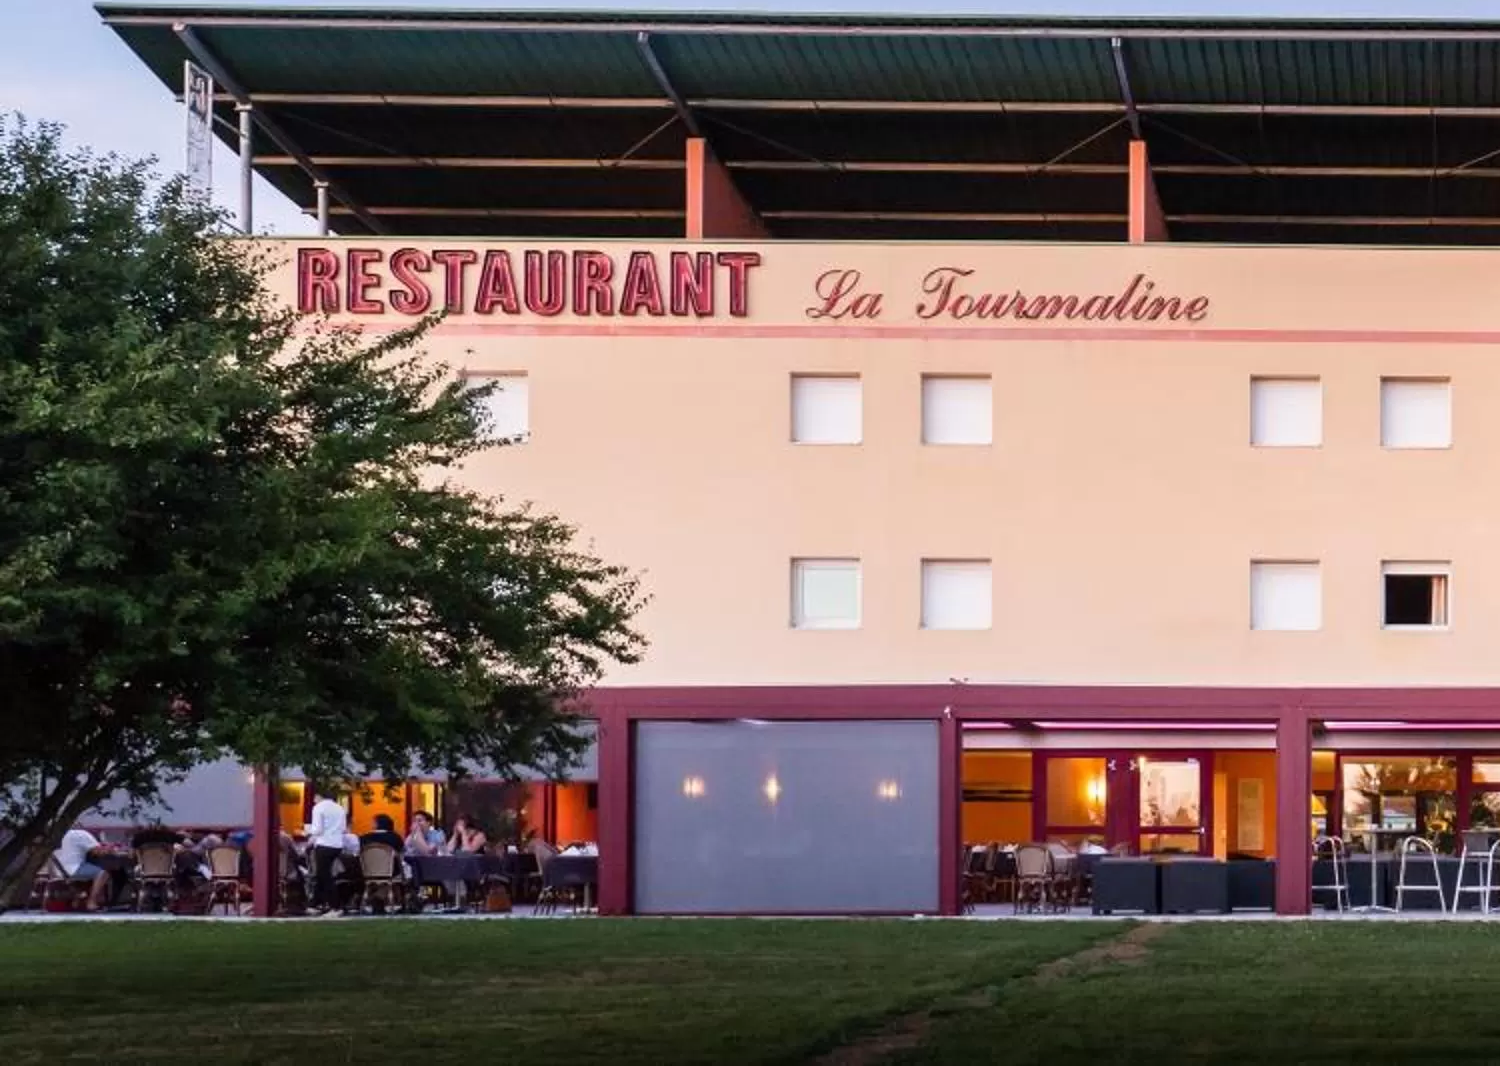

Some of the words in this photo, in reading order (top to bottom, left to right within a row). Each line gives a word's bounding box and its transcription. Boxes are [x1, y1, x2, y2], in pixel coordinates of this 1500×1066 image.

[297, 247, 761, 318] RESTAURANT
[805, 268, 884, 319] La
[915, 267, 1210, 321] Tourmaline
